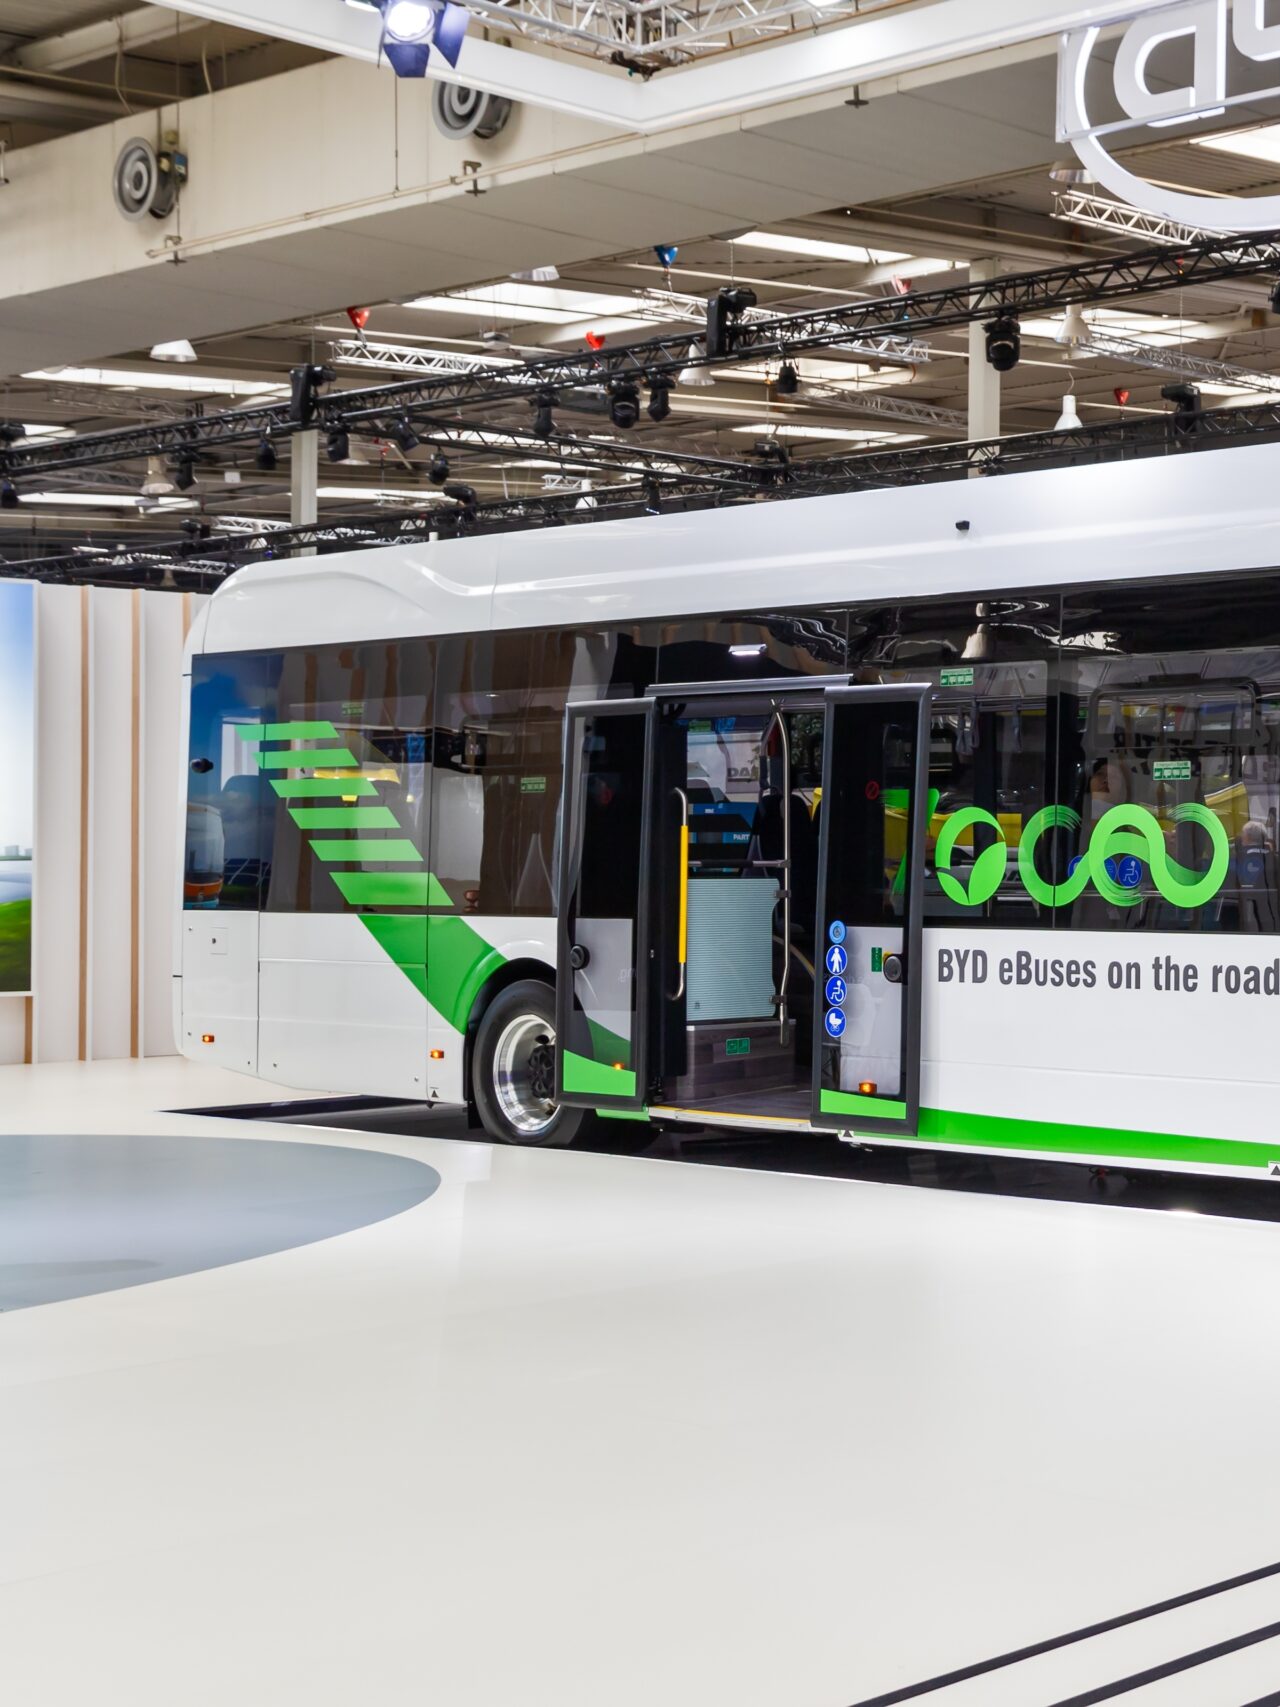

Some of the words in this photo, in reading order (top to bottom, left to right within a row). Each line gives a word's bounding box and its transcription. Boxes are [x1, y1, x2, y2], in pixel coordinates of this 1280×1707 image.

[938, 948, 988, 984] BYD
[999, 950, 1097, 989] eBuses
[1107, 958, 1142, 990] on
[1152, 955, 1199, 992] the
[1212, 958, 1280, 996] road
